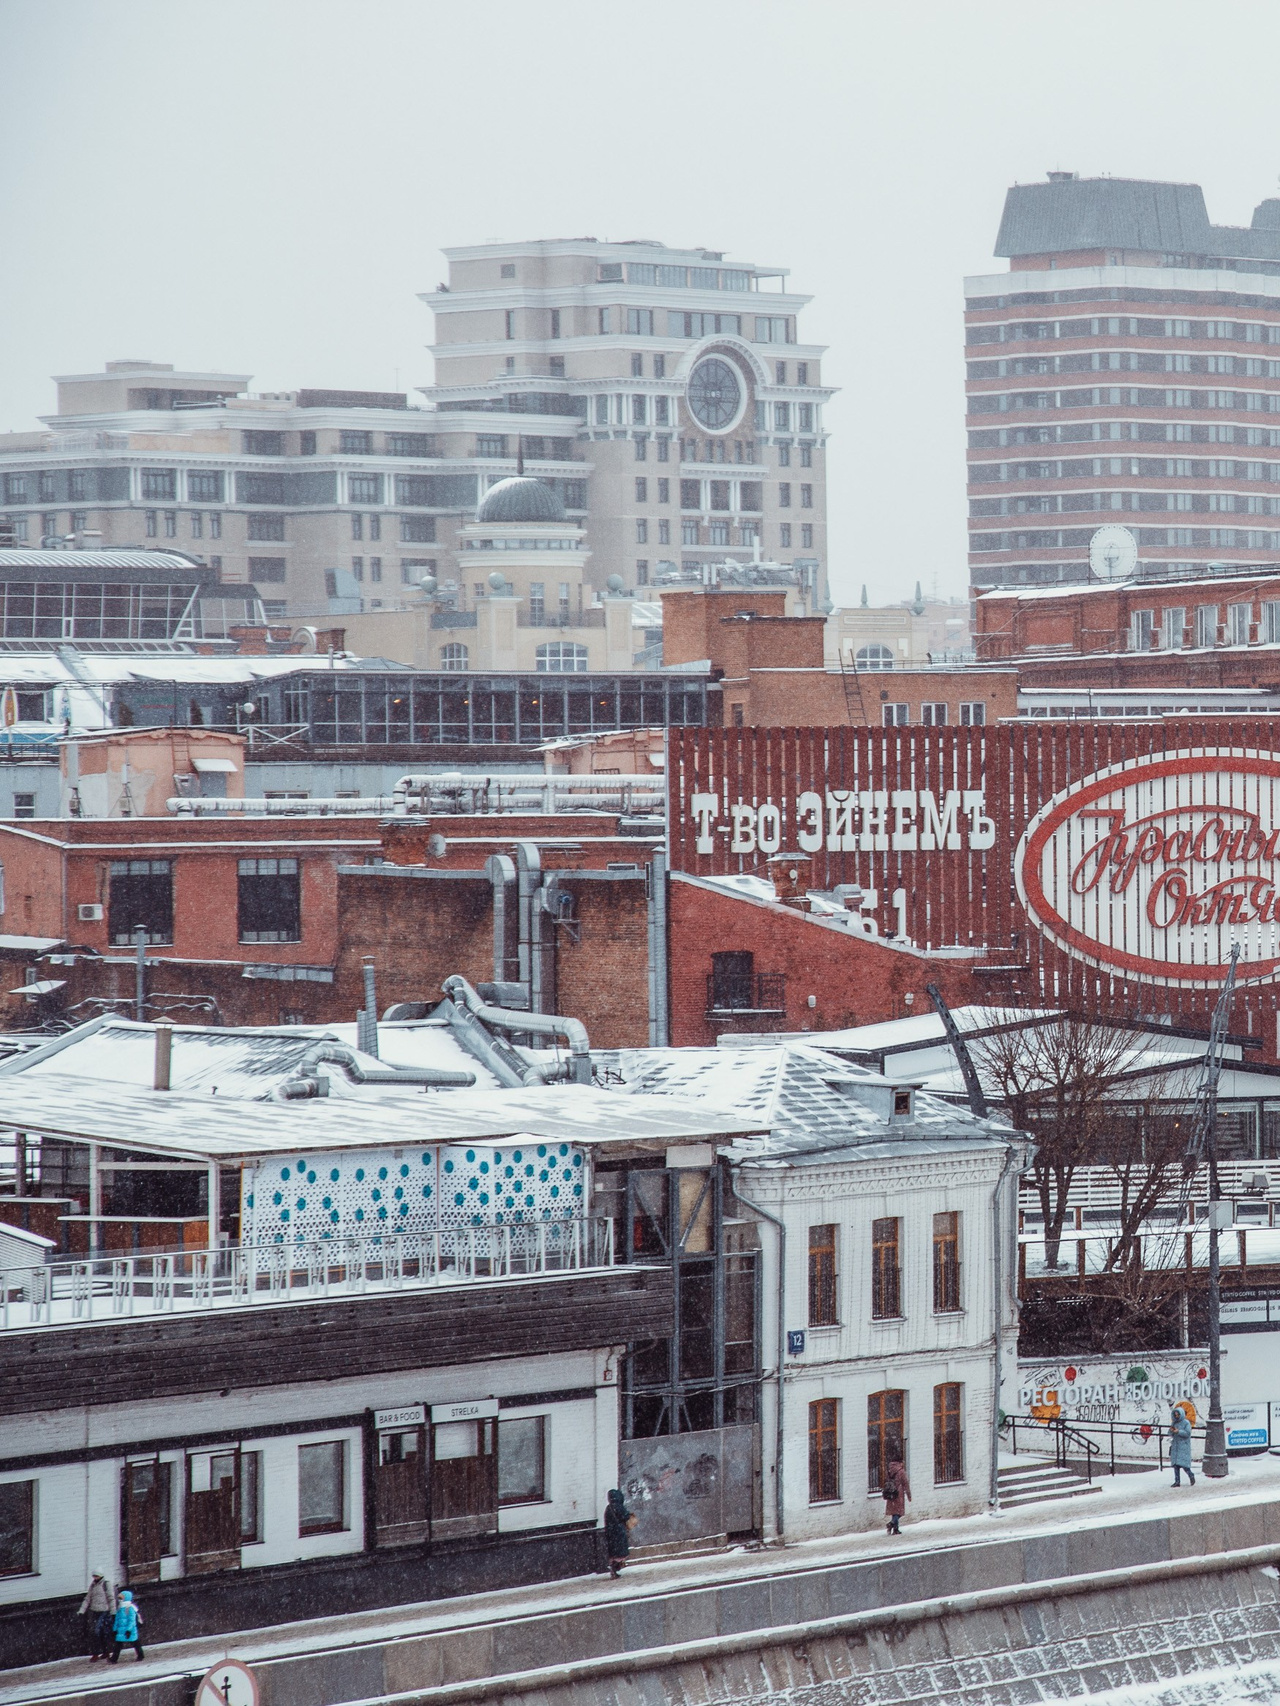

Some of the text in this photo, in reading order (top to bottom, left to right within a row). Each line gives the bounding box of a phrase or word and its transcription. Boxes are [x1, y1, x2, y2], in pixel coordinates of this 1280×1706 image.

[798, 789, 996, 853] ЭЙНЕМЪ
[793, 1334, 802, 1346] 12
[1019, 1384, 1119, 1408] РЕСТОРАН
[379, 1411, 420, 1424] BAR & FOOD
[450, 1406, 479, 1417] STRELKA
